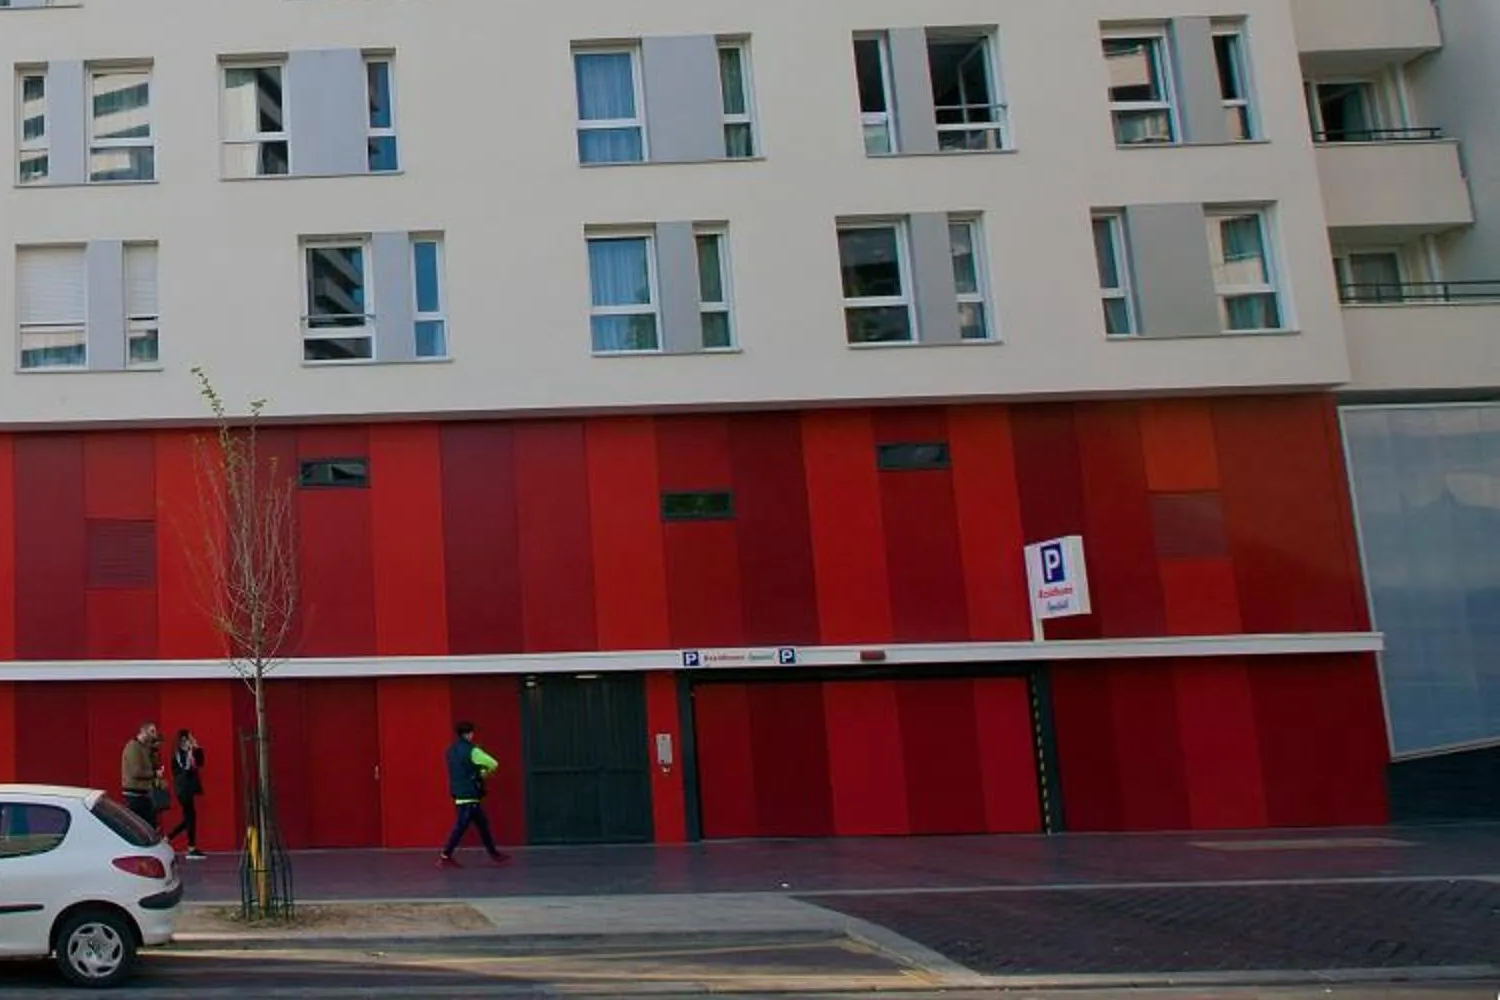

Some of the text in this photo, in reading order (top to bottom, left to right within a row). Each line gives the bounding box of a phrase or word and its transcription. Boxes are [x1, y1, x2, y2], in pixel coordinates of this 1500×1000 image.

[1044, 549, 1061, 580] P
[685, 653, 698, 665] P
[781, 649, 793, 662] P
